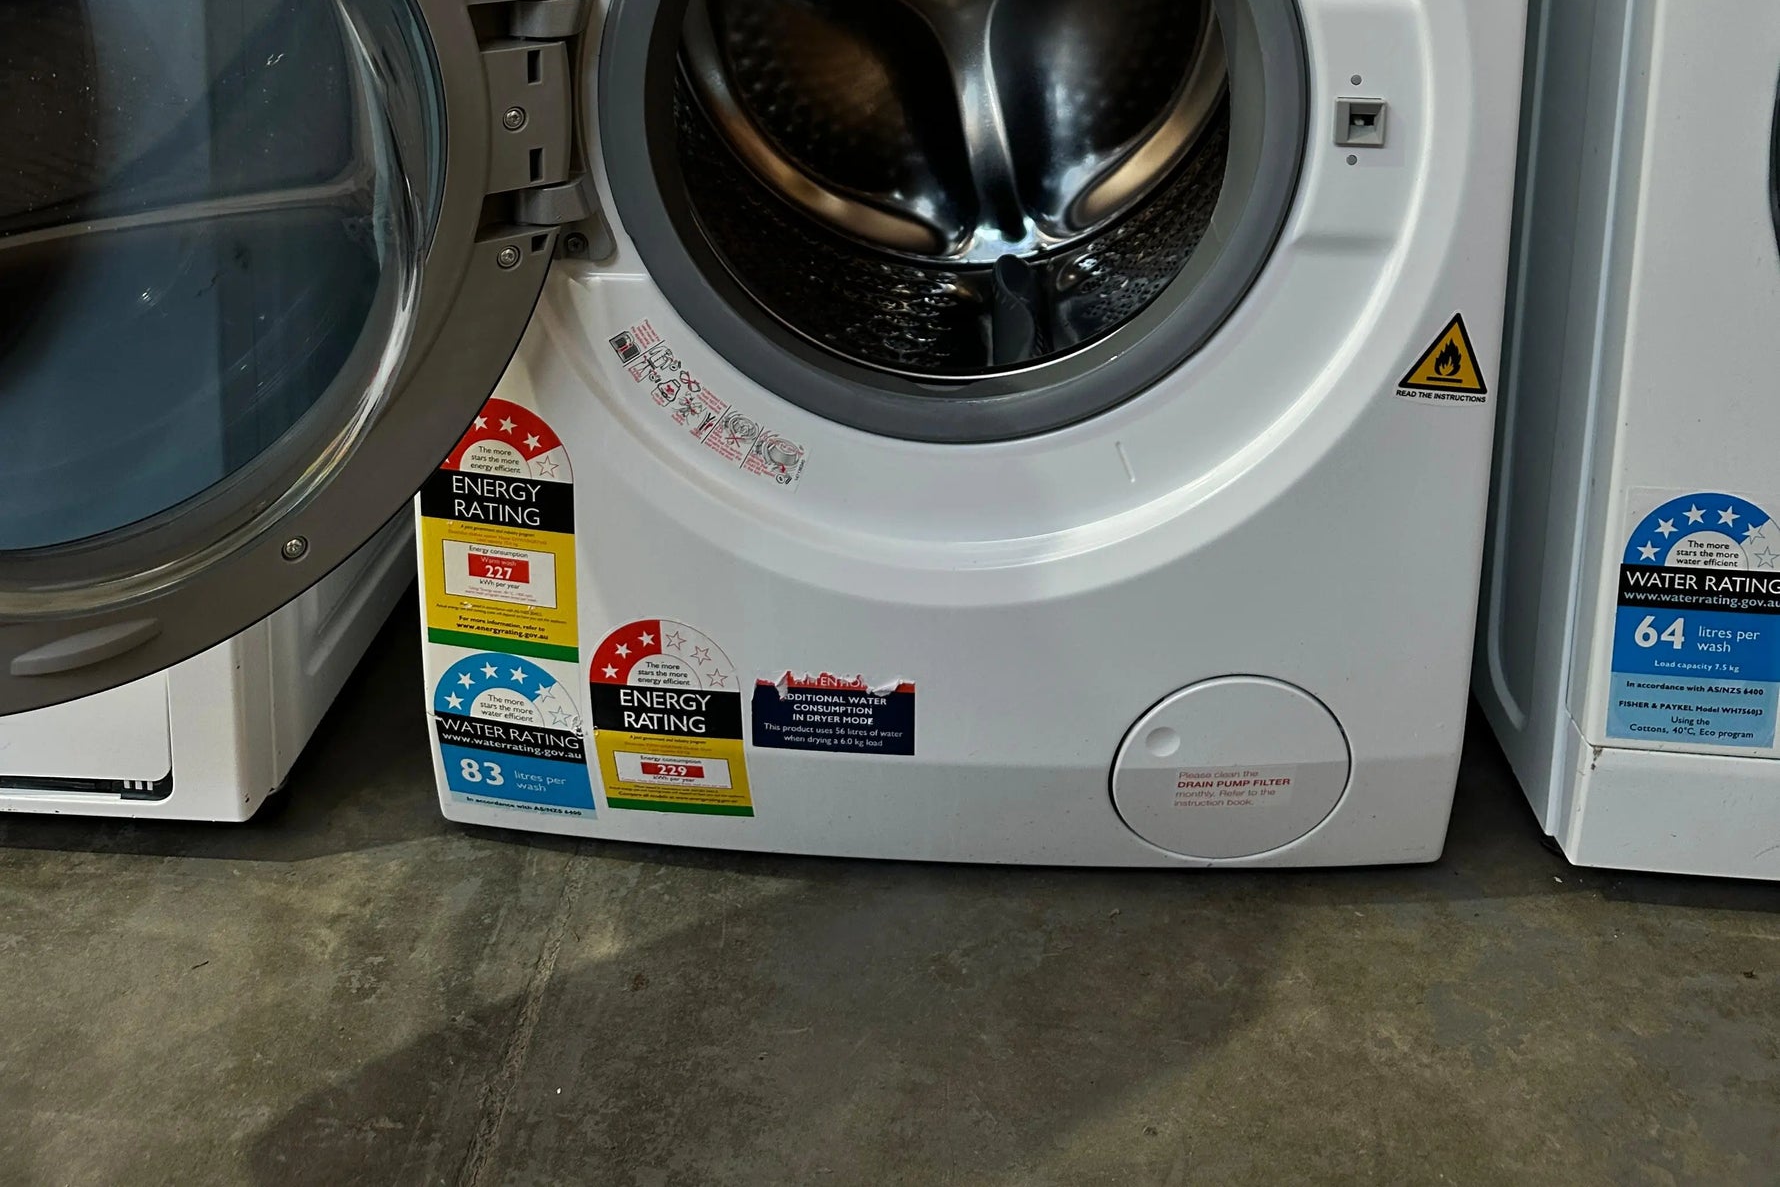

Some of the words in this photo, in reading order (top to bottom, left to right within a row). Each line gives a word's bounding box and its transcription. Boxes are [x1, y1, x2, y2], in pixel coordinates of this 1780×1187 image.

[1434, 393, 1486, 402] INSTRUCTIONS
[479, 446, 492, 455] The
[494, 448, 511, 456] more
[471, 454, 487, 463] stars
[489, 456, 499, 464] the
[471, 462, 492, 472] energy
[494, 464, 521, 474] efficient
[452, 475, 541, 502] ENERGY
[455, 499, 540, 526] RATING
[1688, 540, 1704, 548] The
[1707, 542, 1730, 550] more
[469, 545, 488, 554] Energy
[490, 549, 528, 559] consumption
[1677, 549, 1697, 557] stars
[1700, 550, 1714, 558] the
[1716, 552, 1739, 560] more
[1676, 558, 1701, 566] water
[1704, 559, 1738, 567] efficient
[485, 565, 512, 580] 227
[1626, 571, 1697, 590] WATER
[1705, 576, 1780, 594] RATING
[1624, 591, 1780, 610] www.waterrating.gov.au
[1634, 615, 1685, 650] 64
[1699, 626, 1732, 639] litres
[1737, 629, 1760, 641] per
[1697, 641, 1731, 653] wash
[646, 661, 661, 669] The
[1655, 660, 1675, 668] Load
[1677, 662, 1713, 672] capacity
[1729, 665, 1740, 673] kg
[663, 678, 690, 686] efficient
[1637, 682, 1684, 691] accordance
[1707, 686, 1741, 694] AS/NZS
[488, 694, 501, 703] The
[504, 698, 524, 706] more
[620, 689, 711, 711] ENERGY
[848, 696, 886, 705] WATER
[480, 702, 497, 710] stars
[499, 704, 512, 712] the
[513, 707, 533, 715] more
[794, 704, 872, 714] CONSUMPTION
[1660, 703, 1693, 711] PAYKEL
[481, 710, 501, 718] water
[504, 712, 533, 723] efficient
[624, 712, 706, 733] RATING
[807, 715, 840, 723] DRYER
[843, 717, 873, 725] MODE
[1671, 716, 1694, 726] Using
[1696, 718, 1710, 726] the
[440, 718, 505, 739] WATER
[510, 729, 580, 749] RATING
[764, 723, 780, 731] This
[783, 725, 813, 734] product
[847, 728, 867, 736] litres
[1629, 724, 1669, 734] Cottons,
[1718, 731, 1754, 739] program
[442, 733, 582, 759] www.waterrating.gov.au
[808, 736, 831, 745] drying
[855, 739, 864, 747] kg
[460, 758, 505, 786] 83
[514, 770, 543, 782] litres
[546, 776, 567, 785] per
[657, 764, 687, 776] 229
[1179, 771, 1212, 779] Please
[1243, 770, 1258, 778] the
[516, 783, 547, 792] wash
[1178, 780, 1213, 788] DRAIN
[1216, 780, 1249, 788] PUMP
[1253, 778, 1290, 786] FILTER
[1176, 790, 1215, 798] monthly.
[1174, 799, 1224, 807] instruction
[1227, 798, 1254, 806] book.
